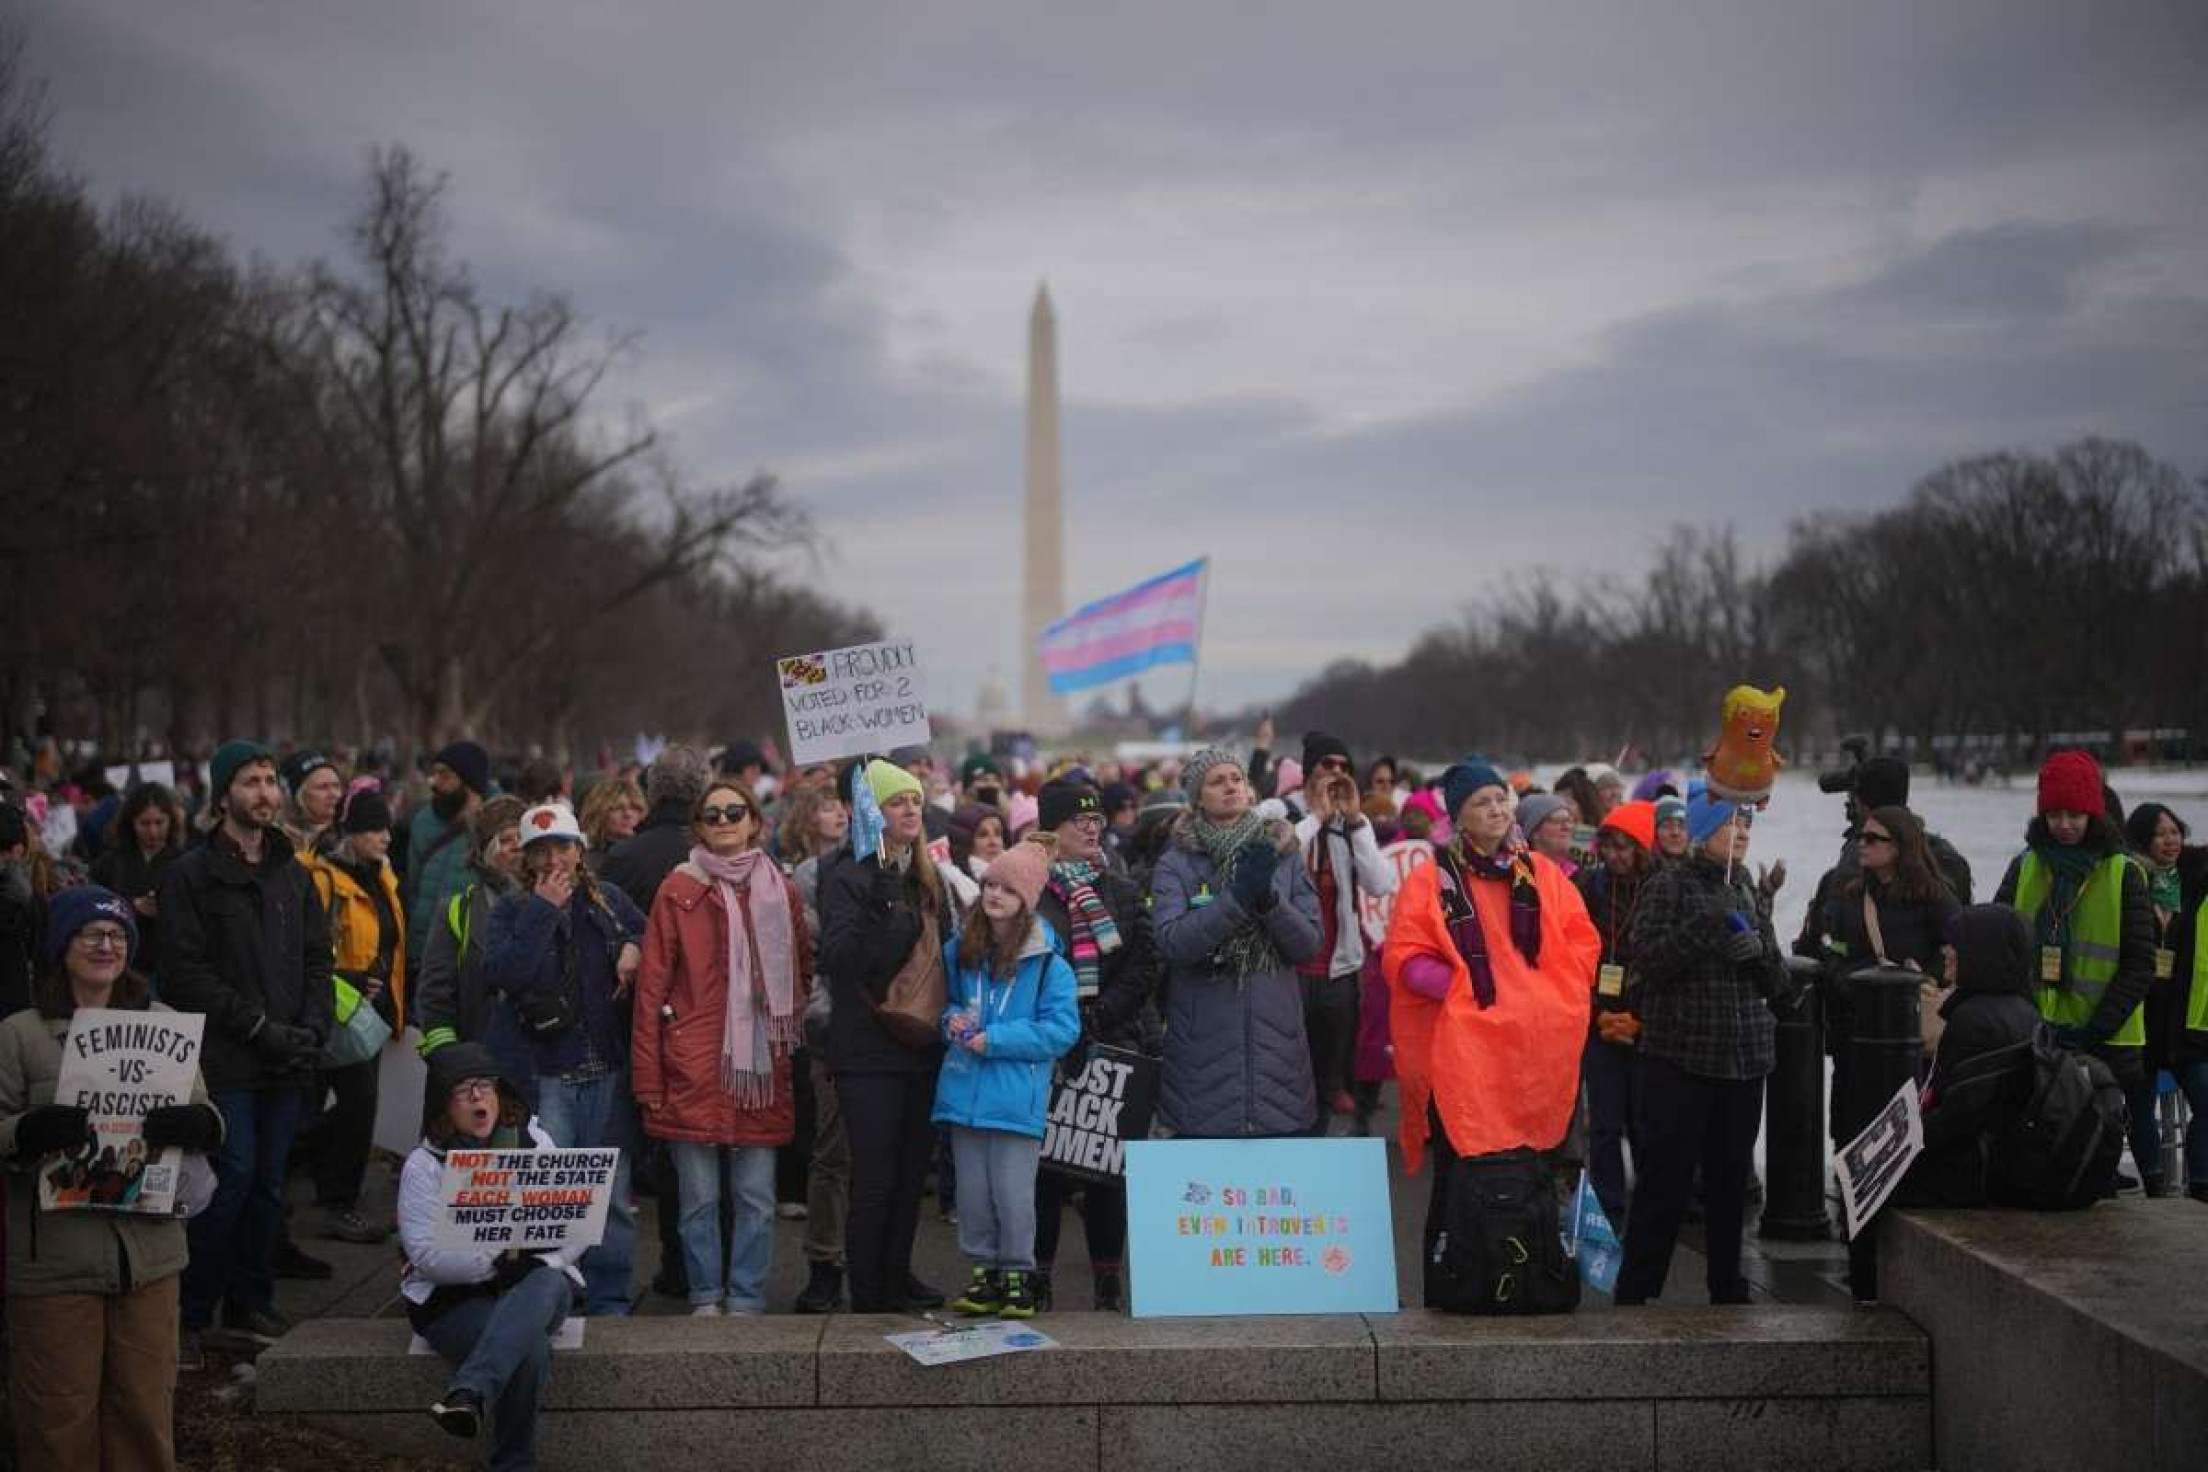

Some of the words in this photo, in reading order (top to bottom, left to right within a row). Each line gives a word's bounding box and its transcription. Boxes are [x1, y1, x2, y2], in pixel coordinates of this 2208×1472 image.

[789, 687, 848, 712] VOTED
[855, 681, 885, 705] FOR
[898, 677, 913, 697] 2
[74, 1024, 195, 1064] FEMINISTS
[451, 1153, 494, 1169] NOT
[497, 1154, 535, 1169] THE
[537, 1153, 614, 1169] CHURCH
[471, 1171, 513, 1186] NOT
[516, 1171, 551, 1186] THE
[553, 1169, 608, 1186] STATE
[456, 1191, 509, 1205] EACH
[521, 1189, 592, 1206] WOMAN
[1222, 1187, 1247, 1206] SO
[455, 1208, 508, 1224] MUST
[511, 1206, 587, 1223] CHOOSE
[473, 1226, 513, 1242] HER
[524, 1225, 567, 1240] FATE
[1177, 1215, 1228, 1236] EVEN
[1210, 1248, 1246, 1266] ARE
[1258, 1248, 1311, 1266] HERE.
